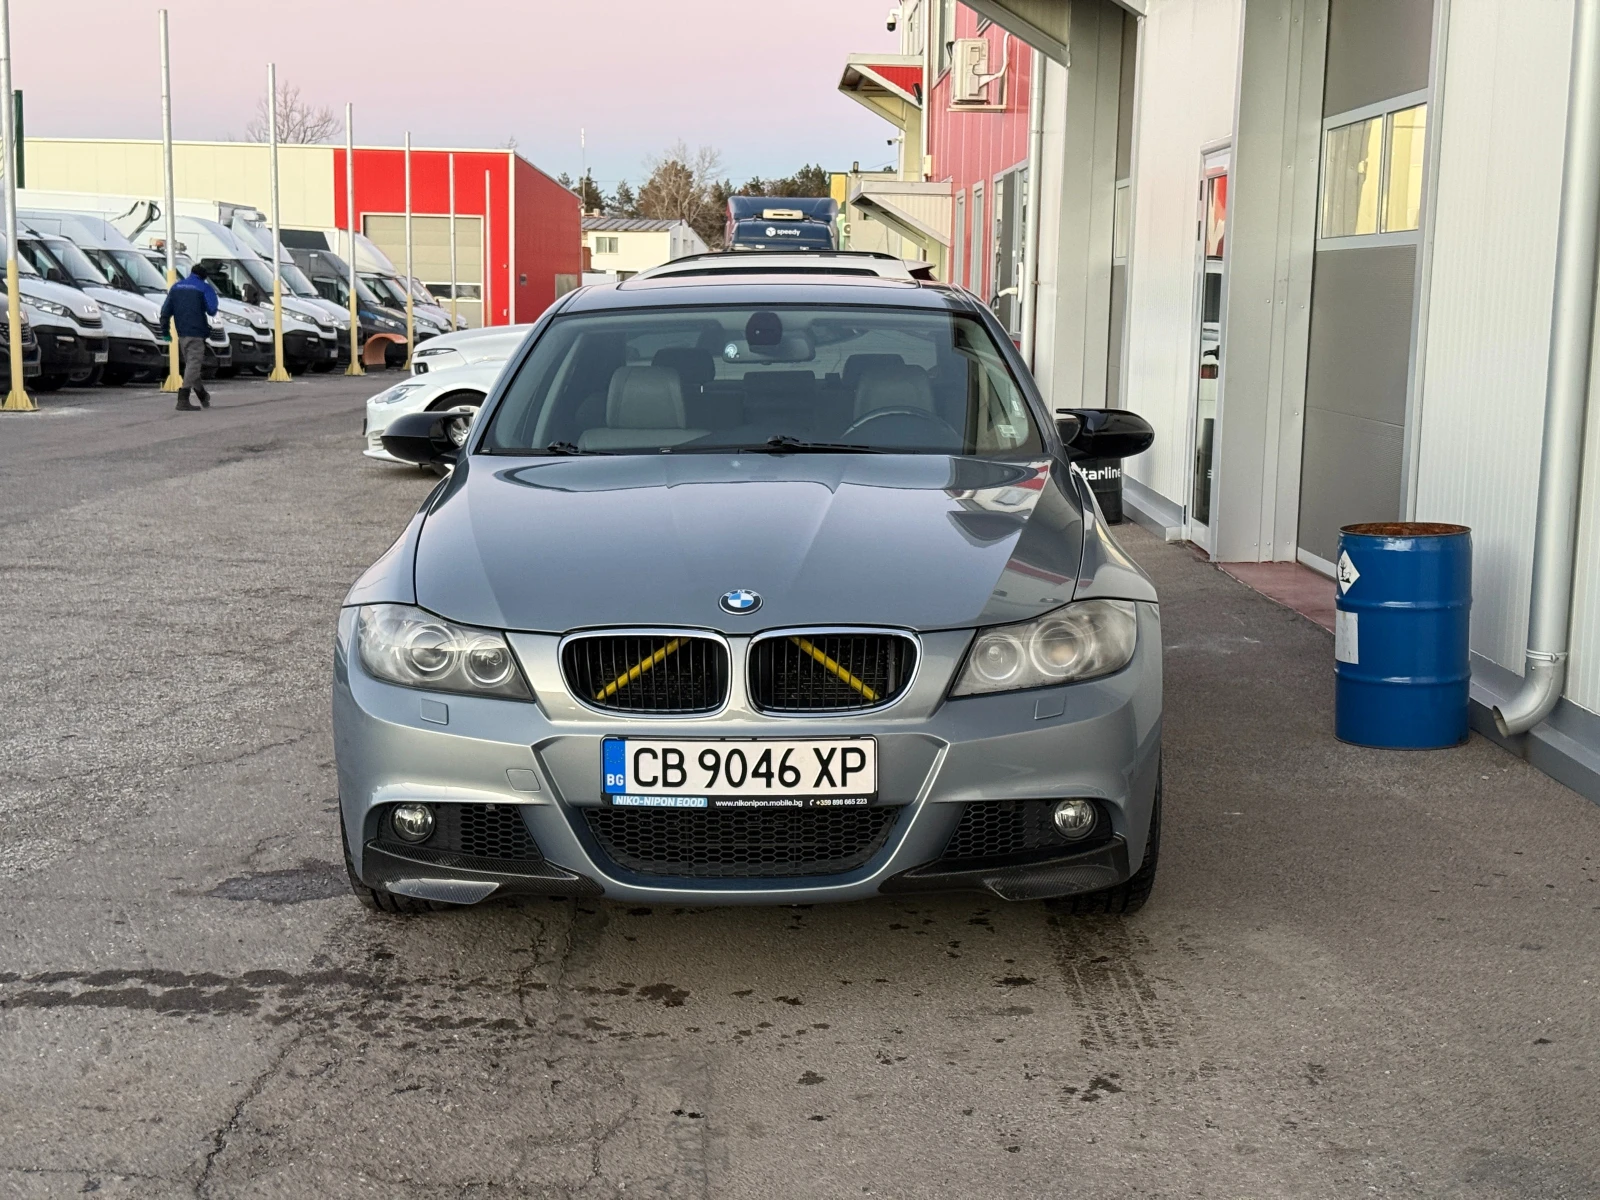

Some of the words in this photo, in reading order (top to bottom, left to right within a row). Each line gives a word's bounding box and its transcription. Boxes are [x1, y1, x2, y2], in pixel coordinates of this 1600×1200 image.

[1079, 466, 1121, 480] tarline
[634, 748, 687, 787] CB
[698, 748, 801, 788] 9046
[813, 747, 867, 787] XP
[607, 774, 624, 786] BG
[616, 795, 675, 806] NIKO-NIPON
[676, 796, 705, 807] EOOD
[715, 799, 803, 808] www.nikonipon.mobile.bg
